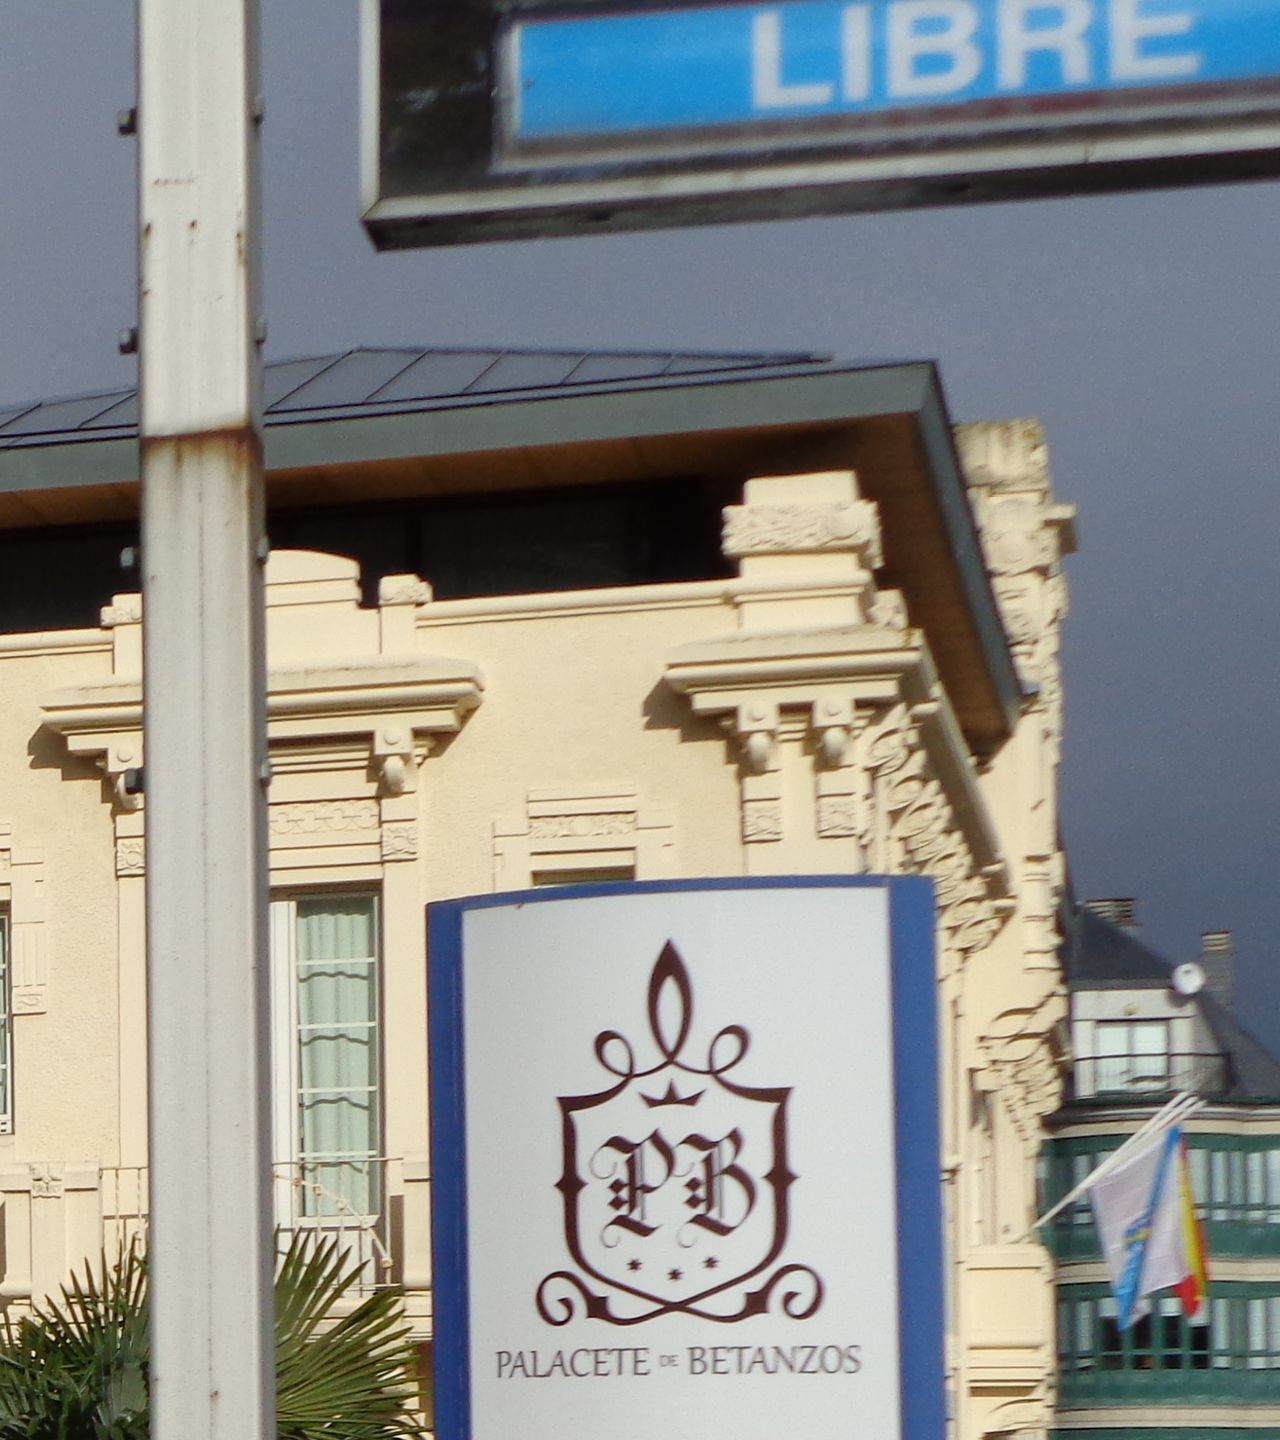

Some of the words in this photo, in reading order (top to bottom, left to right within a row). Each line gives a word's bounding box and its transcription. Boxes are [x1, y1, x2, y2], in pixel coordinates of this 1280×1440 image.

[753, 0, 1202, 109] LIBRE
[495, 1346, 651, 1379] PALACETE
[659, 1354, 679, 1368] DE
[687, 1344, 863, 1377] BETANZOS
